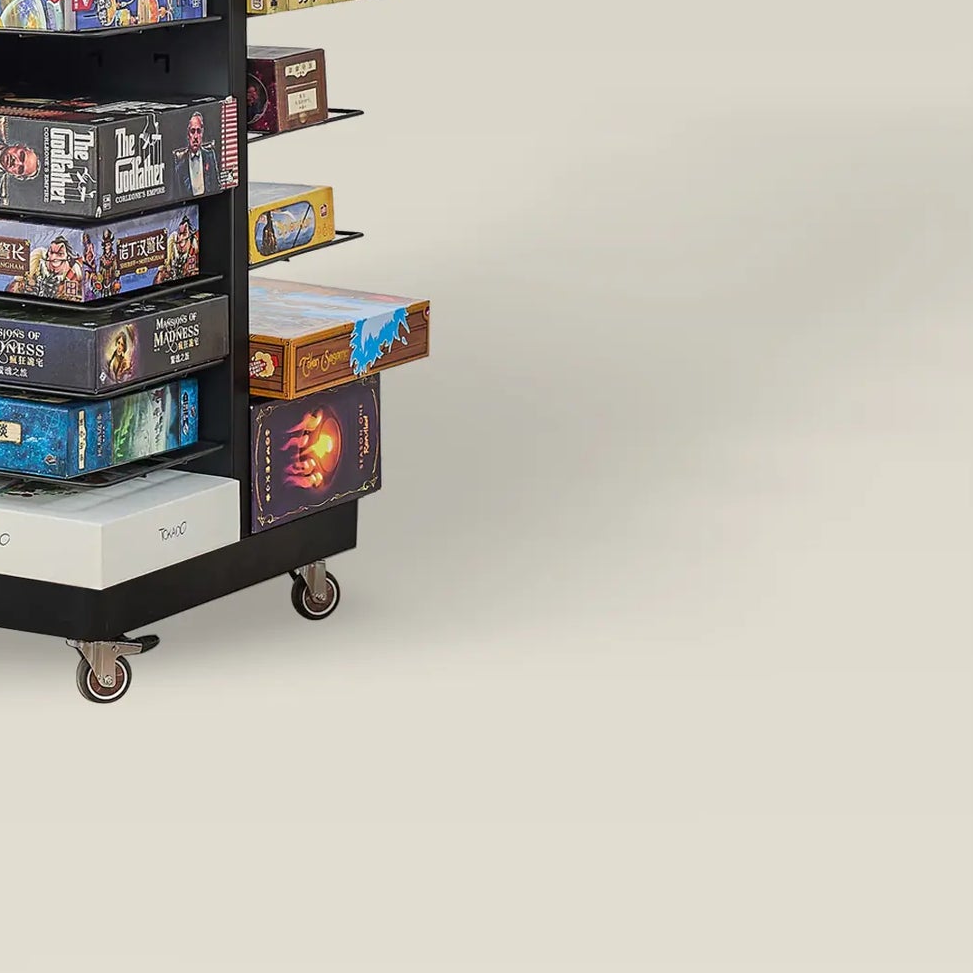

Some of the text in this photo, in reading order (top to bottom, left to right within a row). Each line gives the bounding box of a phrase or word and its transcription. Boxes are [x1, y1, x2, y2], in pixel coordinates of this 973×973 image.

[74, 128, 94, 161] The
[115, 128, 136, 159] The
[49, 128, 76, 205] Godfather
[115, 155, 166, 195] Godfather
[146, 186, 166, 197] EMPIRE
[118, 234, 166, 261] 诺丁汉警长
[156, 311, 198, 331] MANSIONS OF
[28, 330, 41, 341] OF
[153, 324, 200, 348] MADNESS
